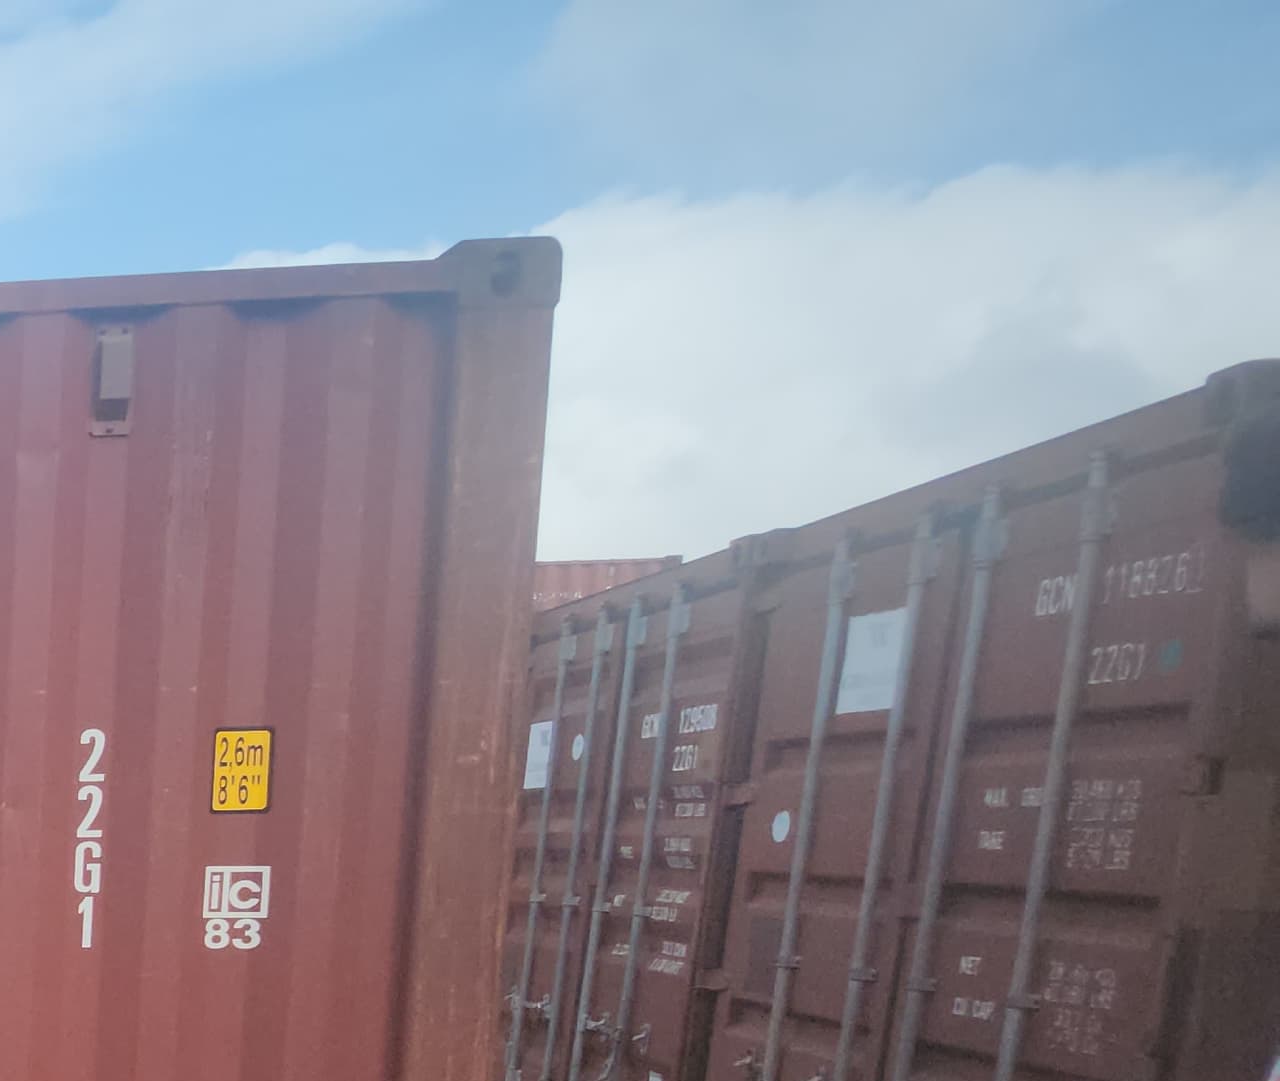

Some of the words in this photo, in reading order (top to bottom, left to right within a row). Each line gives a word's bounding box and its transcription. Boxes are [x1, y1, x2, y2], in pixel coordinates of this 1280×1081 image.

[218, 736, 265, 773] 2,6m
[217, 775, 263, 805] 8'6"
[73, 728, 106, 949] 22G1
[203, 918, 262, 950] 83
